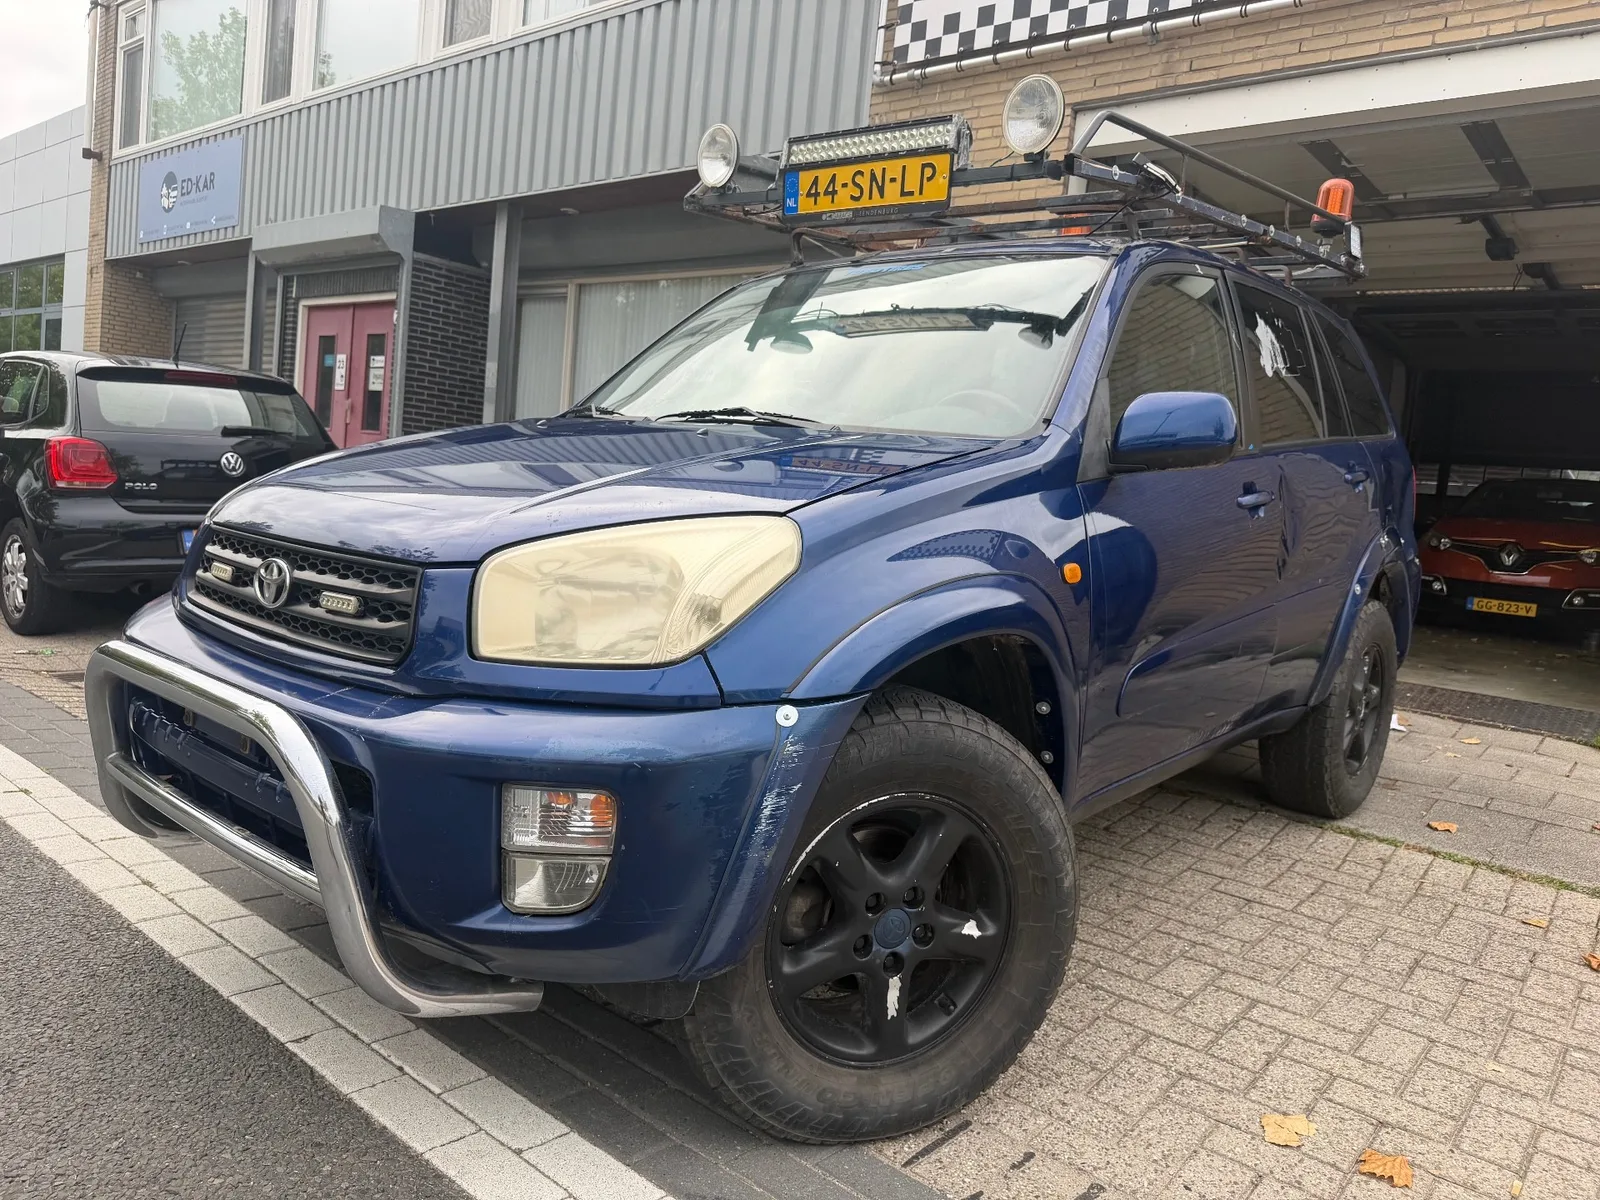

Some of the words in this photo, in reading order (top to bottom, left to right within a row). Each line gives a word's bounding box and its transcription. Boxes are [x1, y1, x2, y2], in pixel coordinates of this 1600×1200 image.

[180, 171, 216, 197] ED-KAR
[805, 161, 937, 206] 44-SN-LP
[786, 198, 797, 208] NL
[124, 482, 158, 490] POLO
[1476, 600, 1532, 614] GG-823-V
